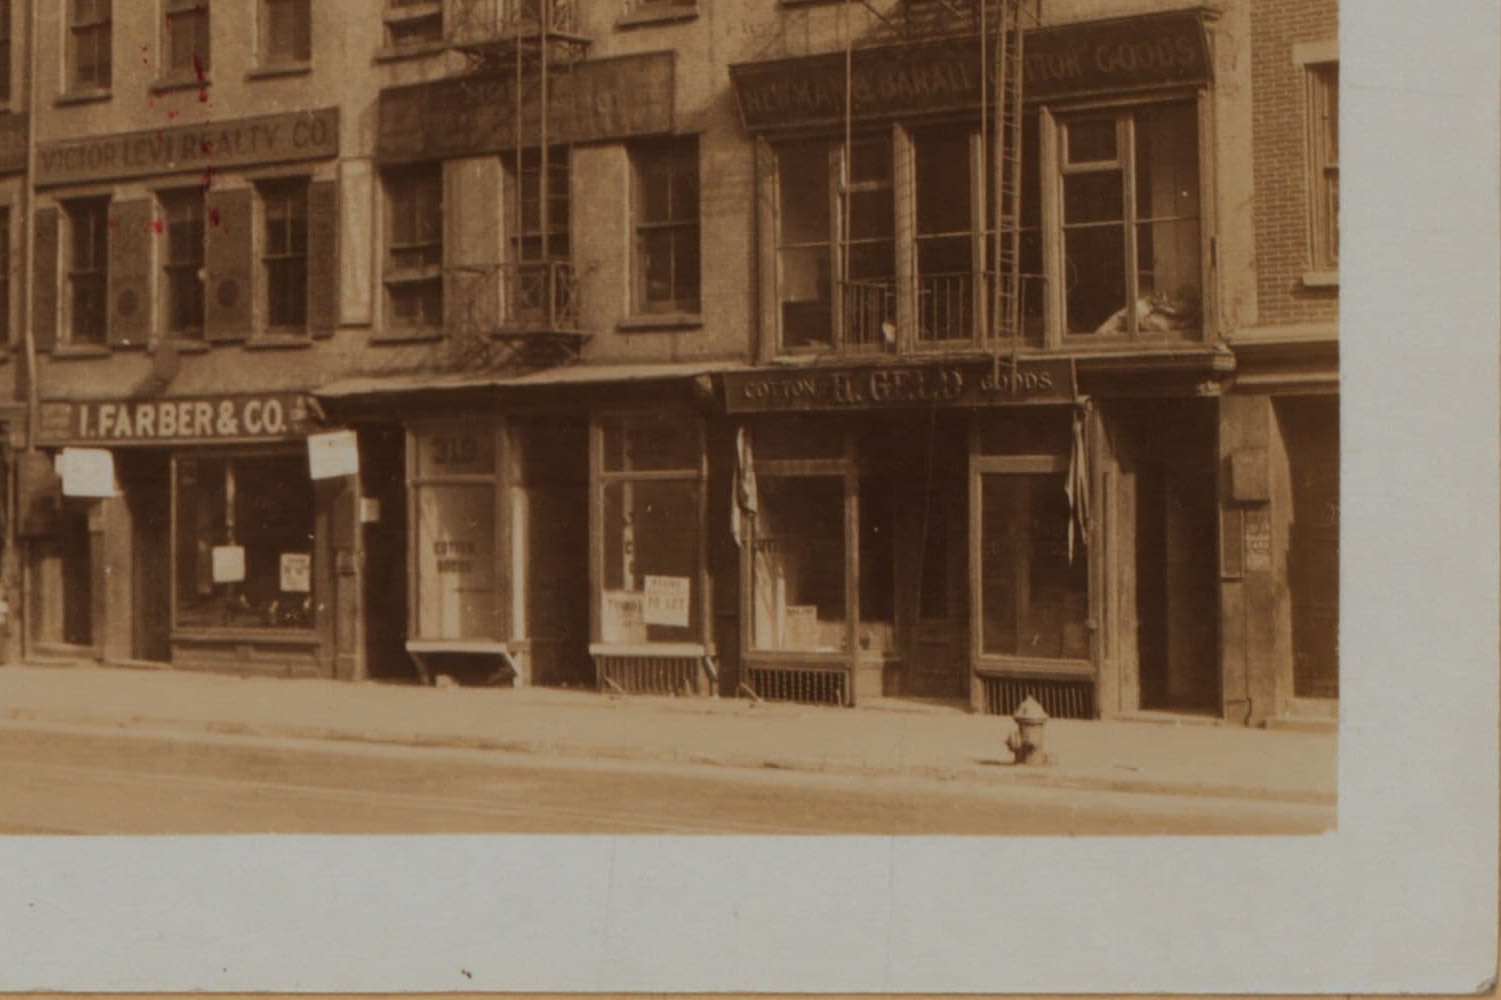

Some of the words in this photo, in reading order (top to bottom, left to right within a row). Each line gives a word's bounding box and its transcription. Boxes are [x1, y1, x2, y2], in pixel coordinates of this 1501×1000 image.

[986, 43, 1082, 84] CTTON
[1095, 35, 1197, 74] GOODS
[39, 142, 117, 173] VICTOR
[123, 132, 173, 167] LEVI
[180, 123, 281, 161] REALTY
[743, 379, 815, 400] COTTON
[98, 401, 213, 438] FARBER
[216, 401, 239, 436] &
[243, 398, 288, 433] CO.
